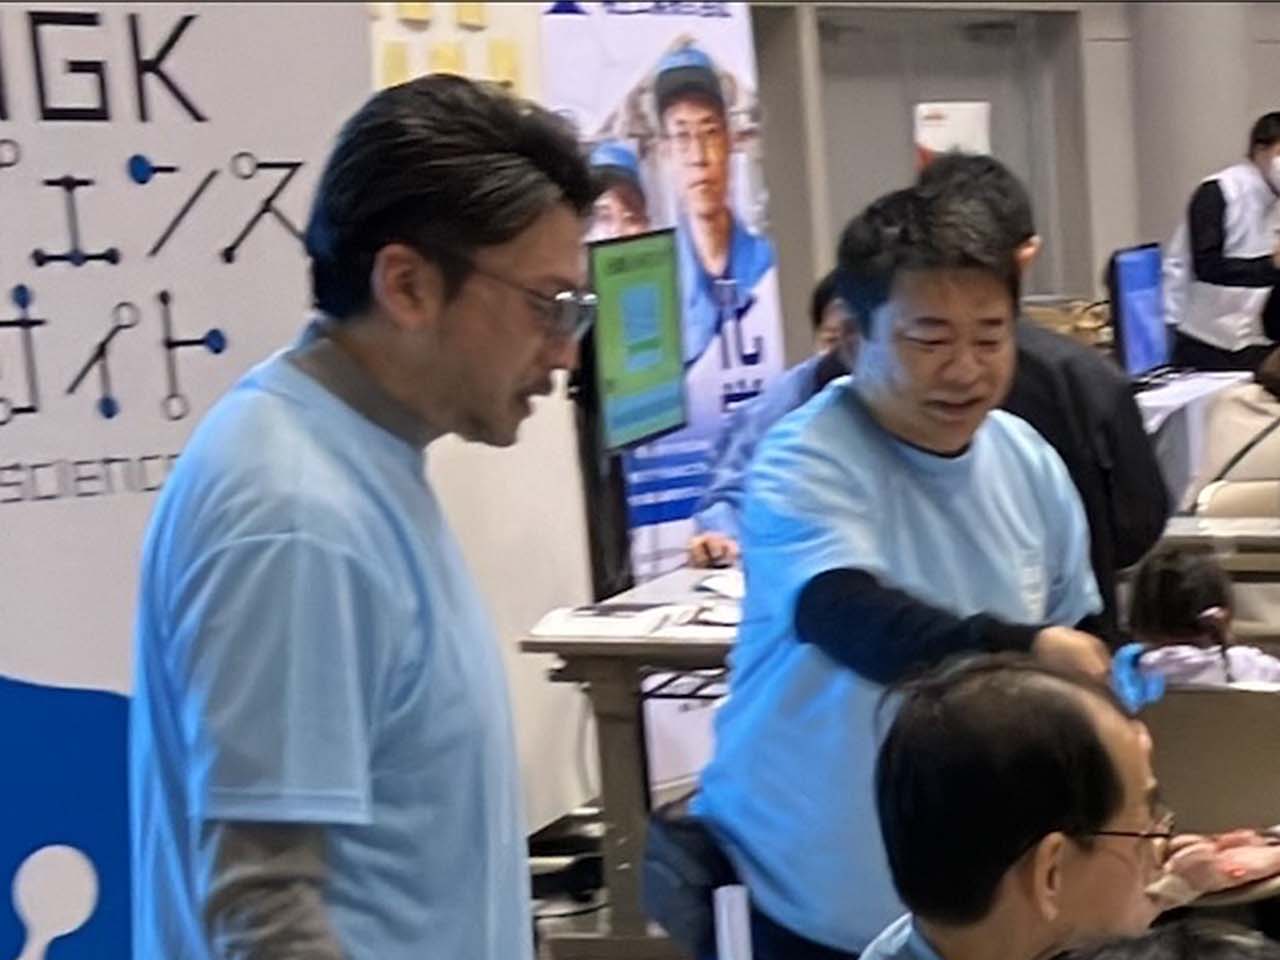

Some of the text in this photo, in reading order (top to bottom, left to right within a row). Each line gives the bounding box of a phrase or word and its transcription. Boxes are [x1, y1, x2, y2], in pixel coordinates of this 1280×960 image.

[0, 12, 208, 122] GK
[0, 139, 306, 266] エンス
